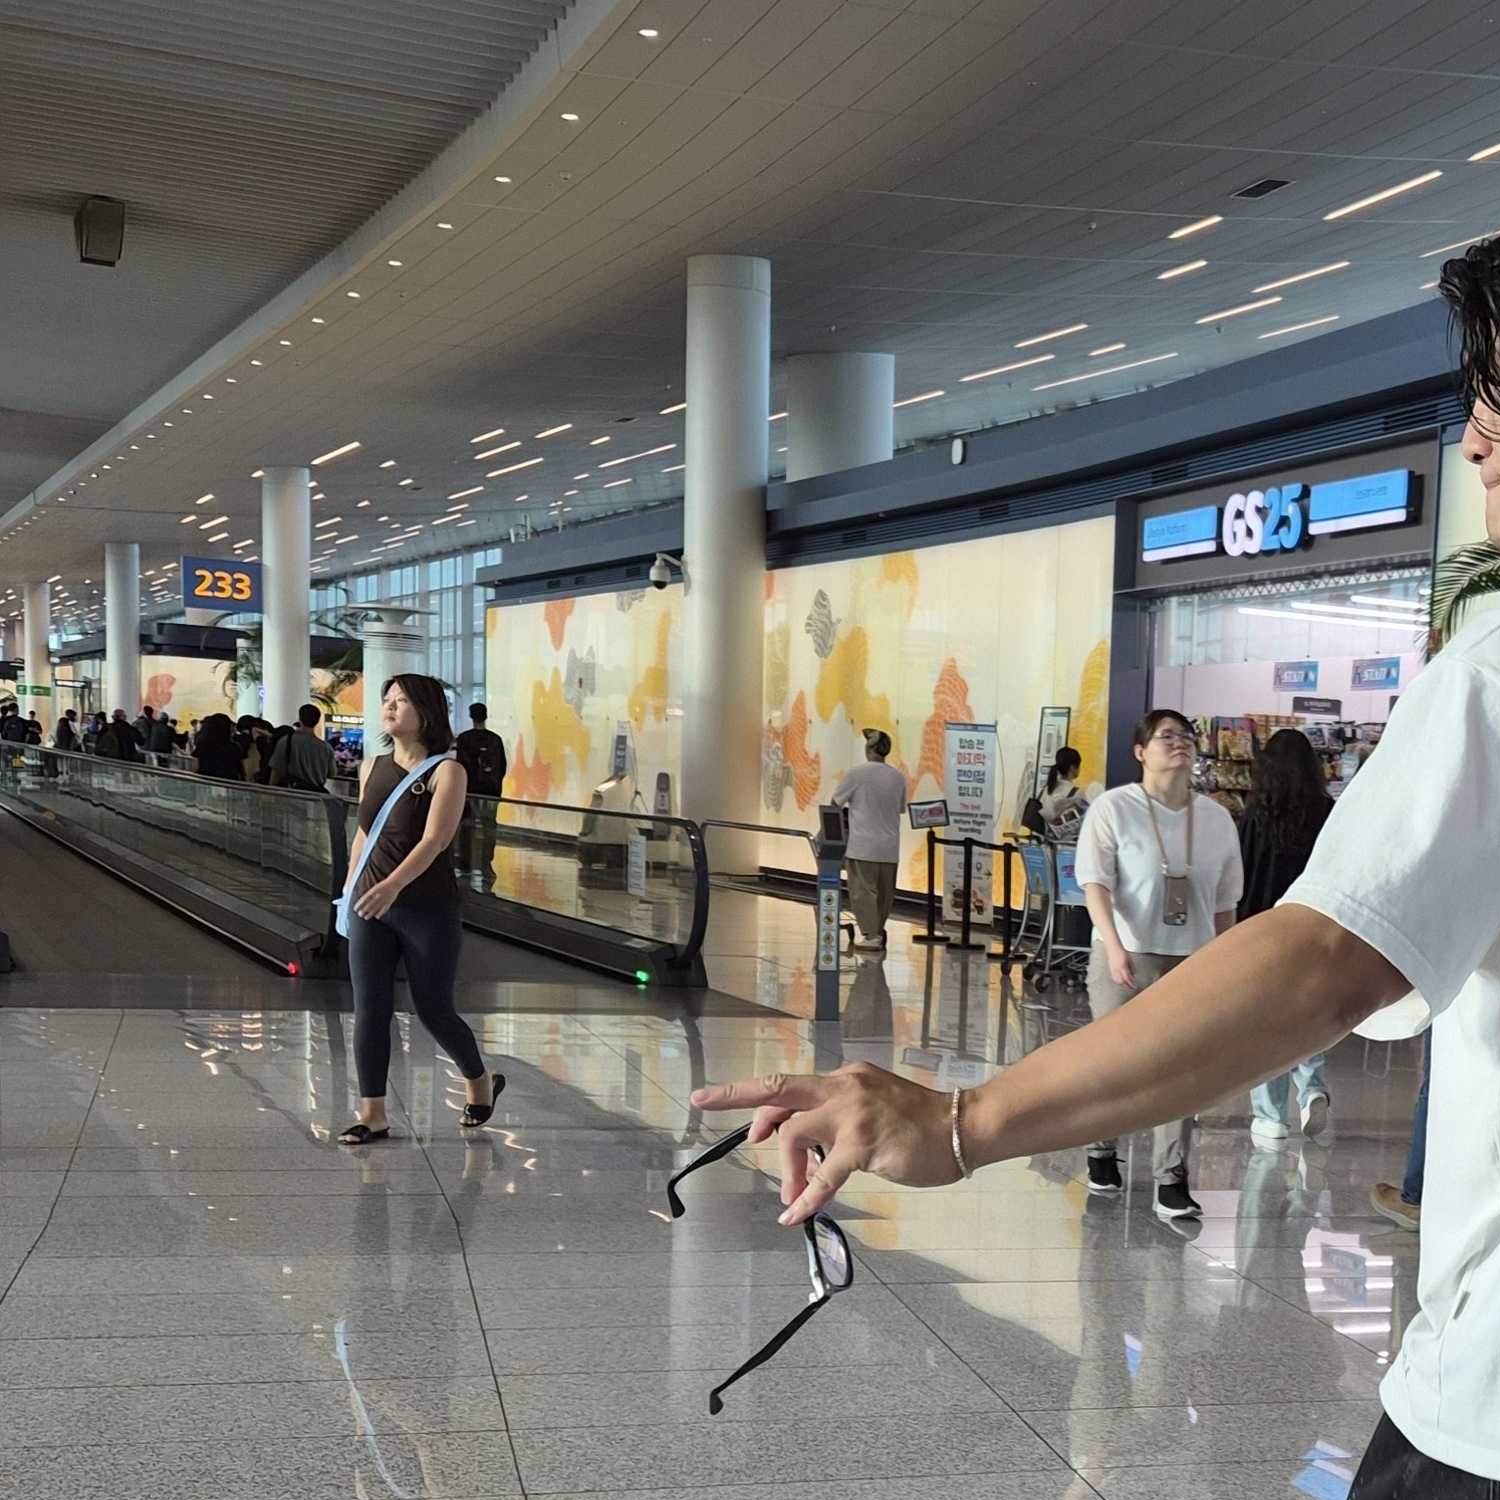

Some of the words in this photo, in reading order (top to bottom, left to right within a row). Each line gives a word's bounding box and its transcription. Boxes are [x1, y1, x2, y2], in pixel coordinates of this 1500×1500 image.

[1222, 483, 1303, 557] GS25
[194, 569, 251, 600] 233
[957, 752, 986, 766] 마지막
[957, 769, 985, 783] 편의점
[958, 786, 983, 797] 입니다
